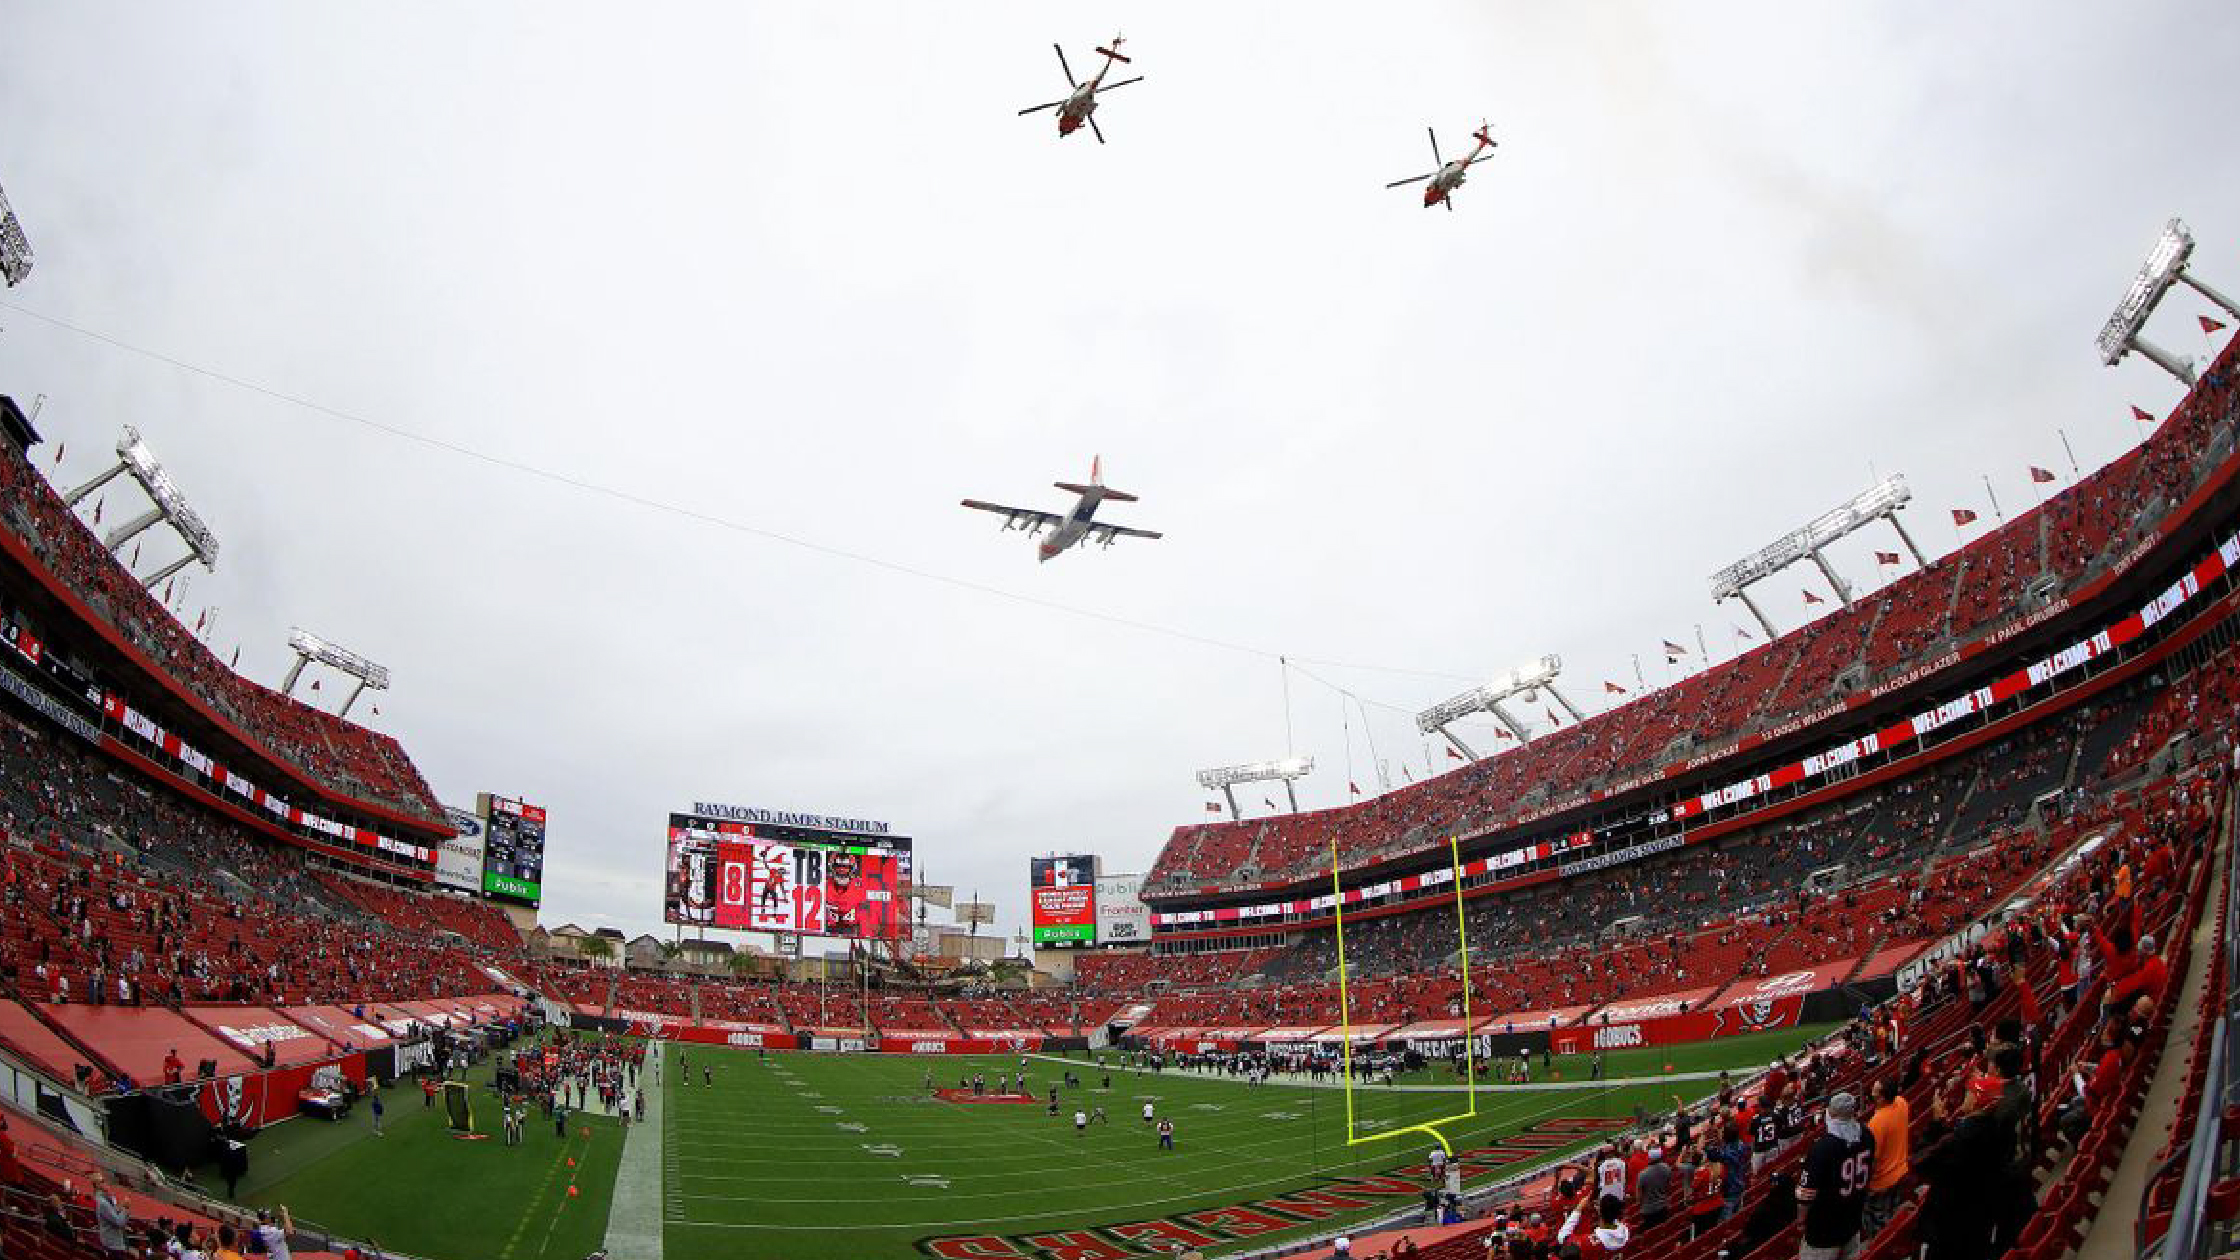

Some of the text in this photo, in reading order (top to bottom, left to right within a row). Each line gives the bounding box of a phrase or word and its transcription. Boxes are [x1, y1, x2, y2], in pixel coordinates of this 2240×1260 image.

[2028, 630, 2111, 686] WELCOME TO
[1912, 686, 1993, 736] WELCOME TO
[1803, 733, 1878, 778] WELCOME TO
[1701, 779, 1757, 811] WELCOME
[1755, 773, 1771, 794] TO
[694, 802, 888, 834] RAYMOND JAMES STADIUM
[793, 850, 821, 885] TB
[792, 885, 822, 929] 12
[1840, 1150, 1871, 1197] 95
